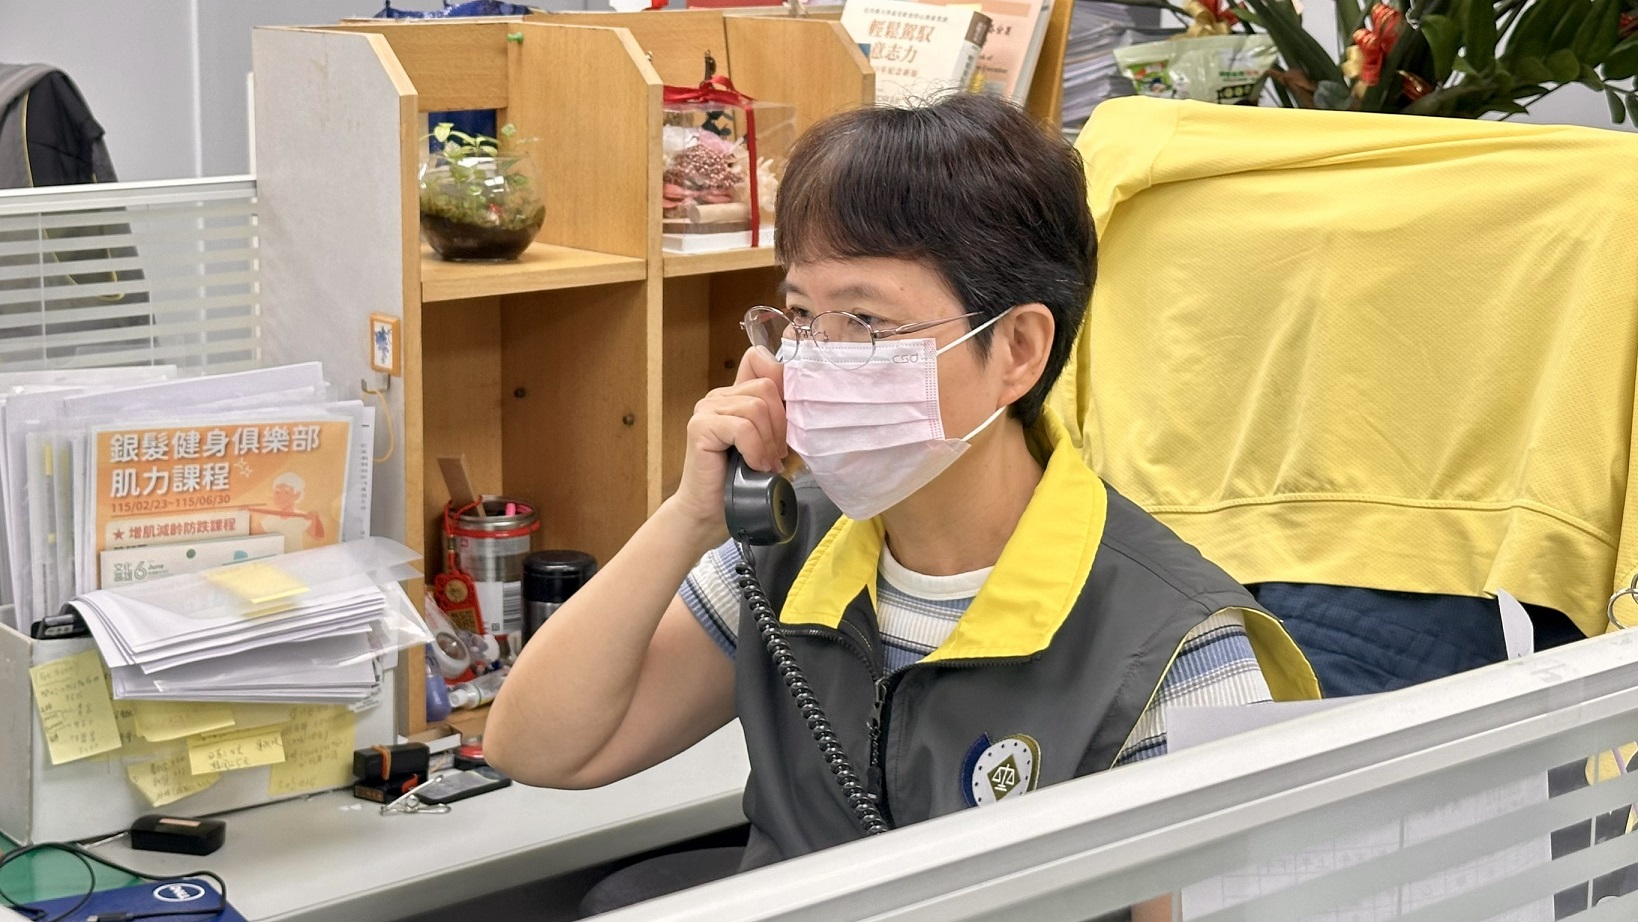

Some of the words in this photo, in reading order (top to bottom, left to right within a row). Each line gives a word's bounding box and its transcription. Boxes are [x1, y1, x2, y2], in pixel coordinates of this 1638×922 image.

[868, 18, 936, 43] 輕鬆駕馭
[871, 41, 918, 64] 意志力
[892, 353, 919, 364] csd
[110, 424, 321, 463] 銀髮健身俱樂部
[110, 461, 230, 498] 肌力課程
[111, 494, 231, 513] 115/02/23~115/06/30
[129, 517, 237, 539] 增肌減齡防跌課程
[134, 561, 147, 580] 6
